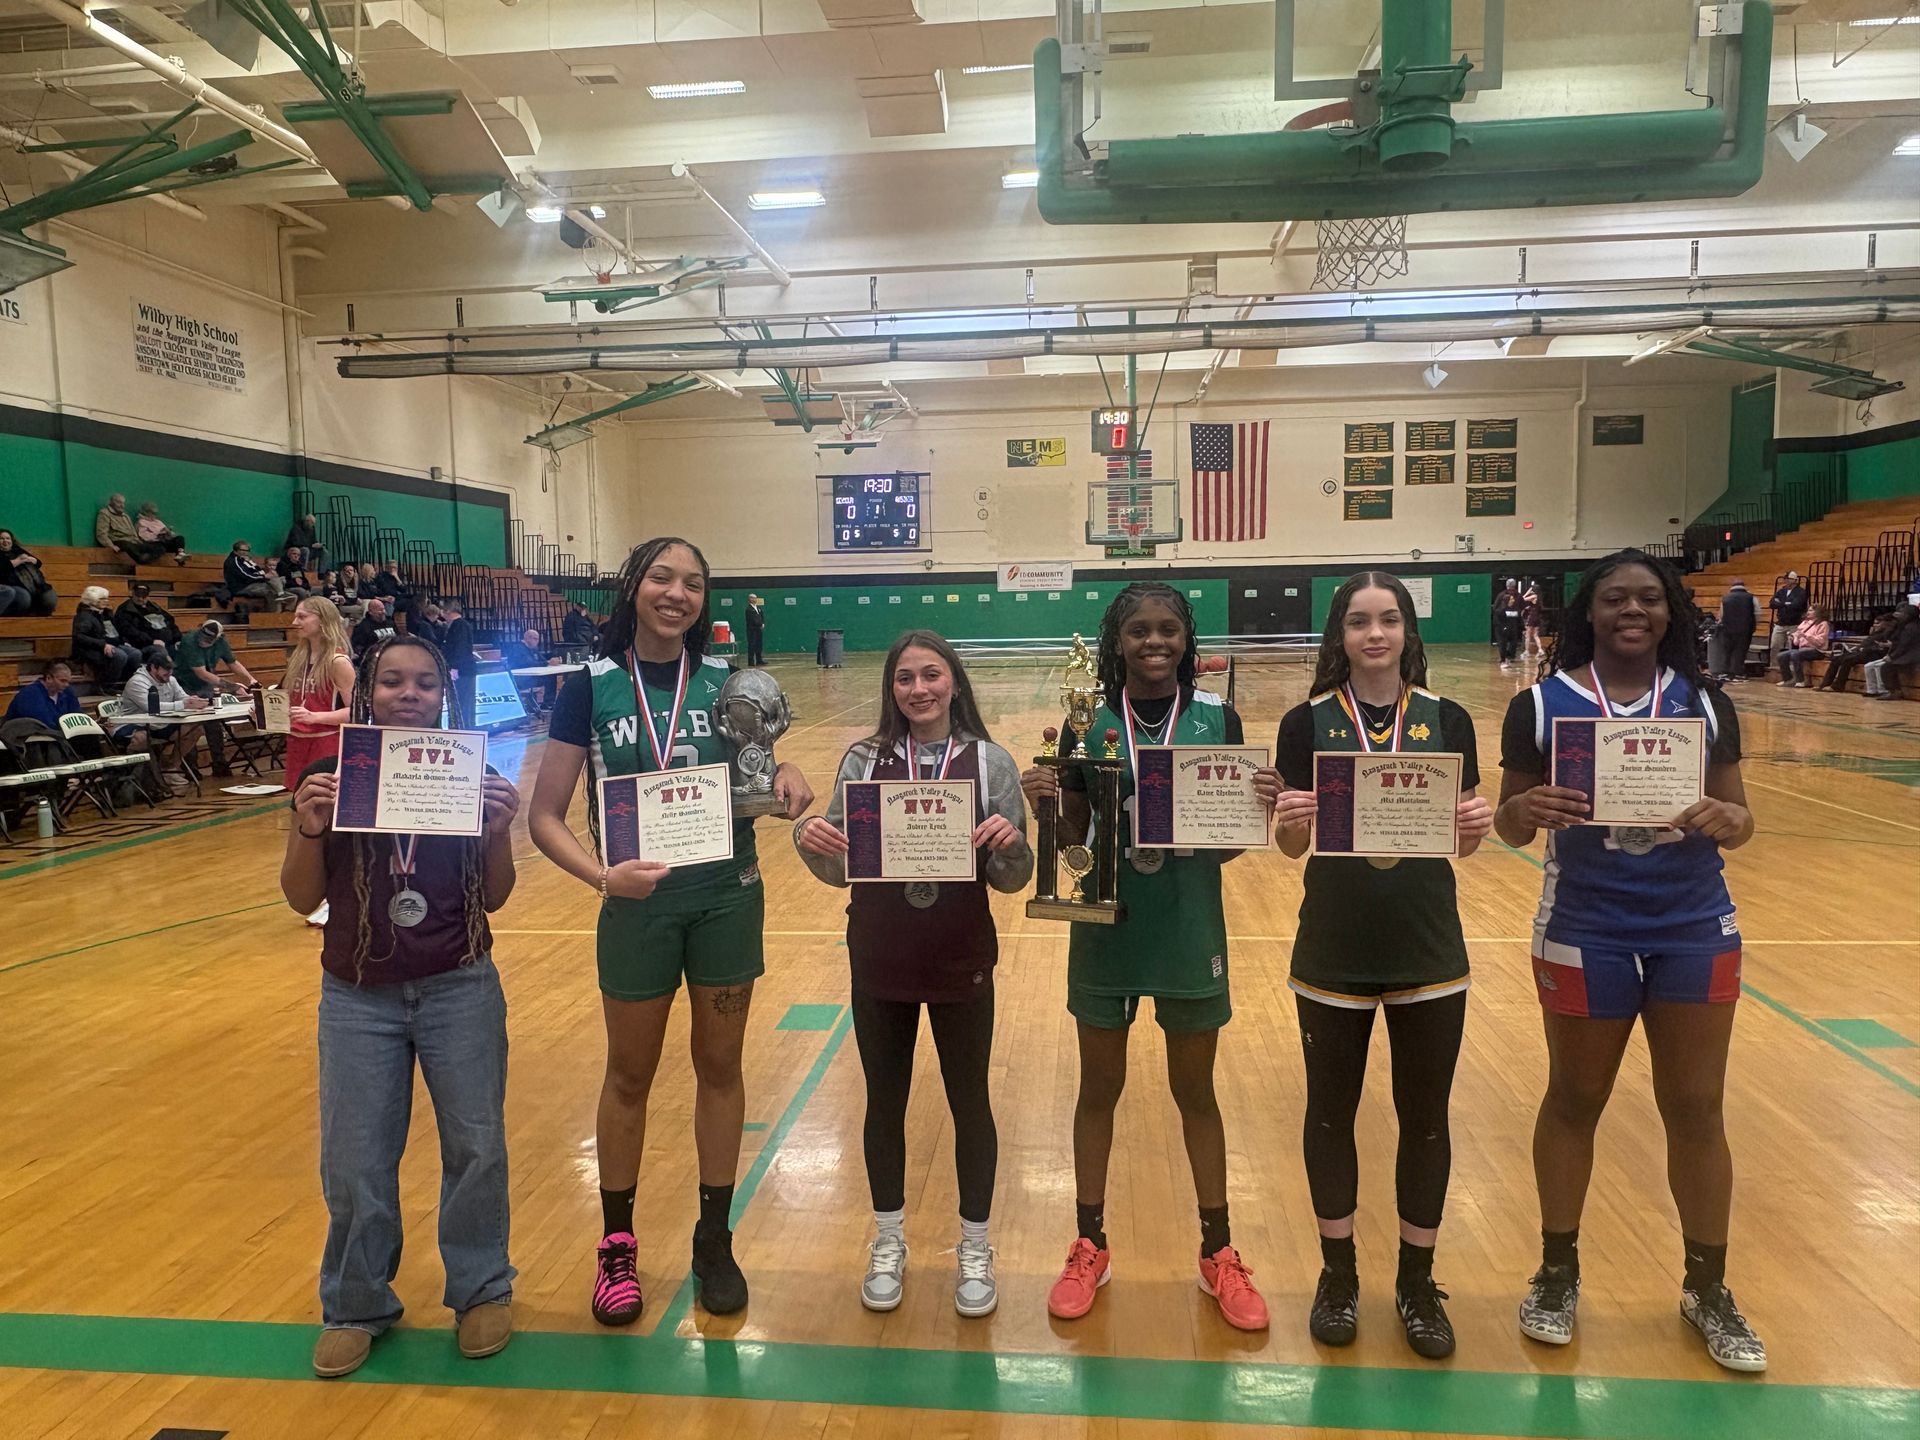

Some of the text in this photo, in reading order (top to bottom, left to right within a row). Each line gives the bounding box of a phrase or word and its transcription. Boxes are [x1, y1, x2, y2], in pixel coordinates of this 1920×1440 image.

[138, 303, 239, 346] Wilby High School
[152, 328, 163, 338] the
[201, 340, 218, 355] Valley
[221, 346, 242, 359] League
[1100, 411, 1128, 424] 19:30
[864, 479, 892, 492] 19:30
[847, 505, 856, 519] 0
[907, 504, 916, 518] 0
[63, 716, 94, 729] WILBY
[1641, 726, 1666, 736] Valley
[1668, 728, 1692, 745] League
[426, 736, 451, 747] Valley
[452, 739, 474, 756] League
[1623, 739, 1672, 755] NVL
[407, 747, 455, 765] NVL
[1213, 753, 1236, 762] Valley
[1197, 765, 1241, 780] NVL
[1399, 761, 1424, 771] Valley
[1425, 764, 1448, 779] League
[675, 775, 696, 784] Valley
[698, 776, 718, 788] League
[1381, 773, 1428, 788] NVL
[661, 785, 702, 804] NVL
[919, 787, 941, 796] Valley
[942, 789, 963, 805] League
[904, 799, 946, 815] NVL
